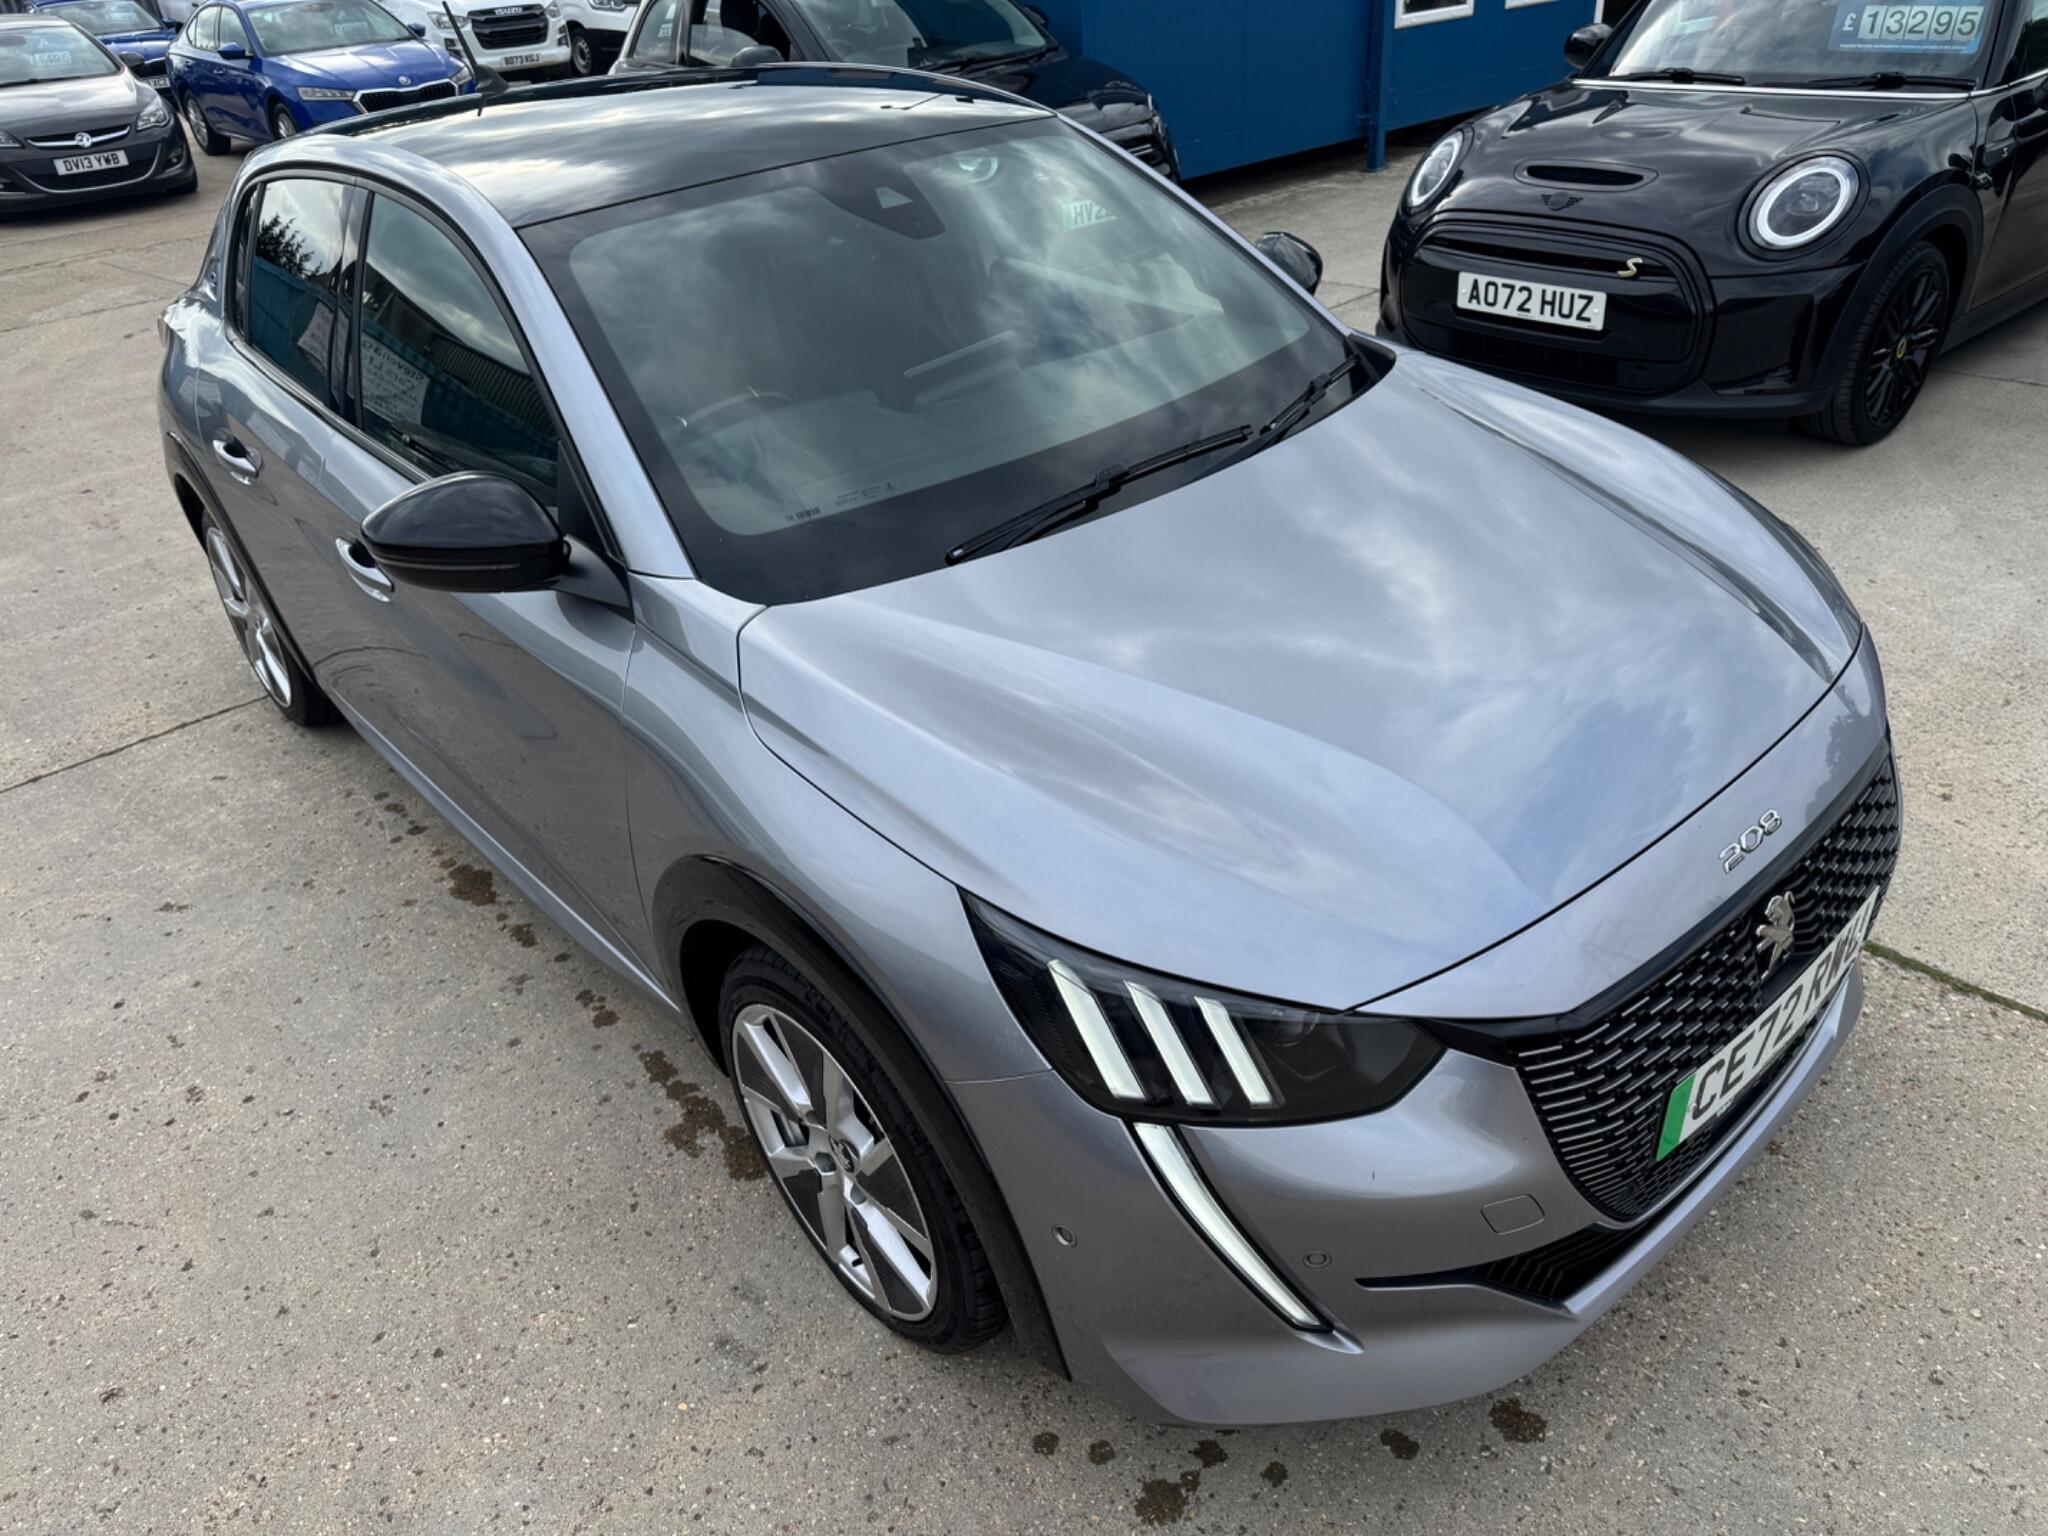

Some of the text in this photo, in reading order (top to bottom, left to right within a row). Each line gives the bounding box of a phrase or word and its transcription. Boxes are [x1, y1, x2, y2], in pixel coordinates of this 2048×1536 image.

[495, 6, 522, 16] ISUZU
[63, 153, 120, 172] DV13 YWB
[1468, 279, 1594, 322] AO72 HUZ
[1720, 809, 1782, 874] 208
[1692, 984, 1804, 1120] CE72
